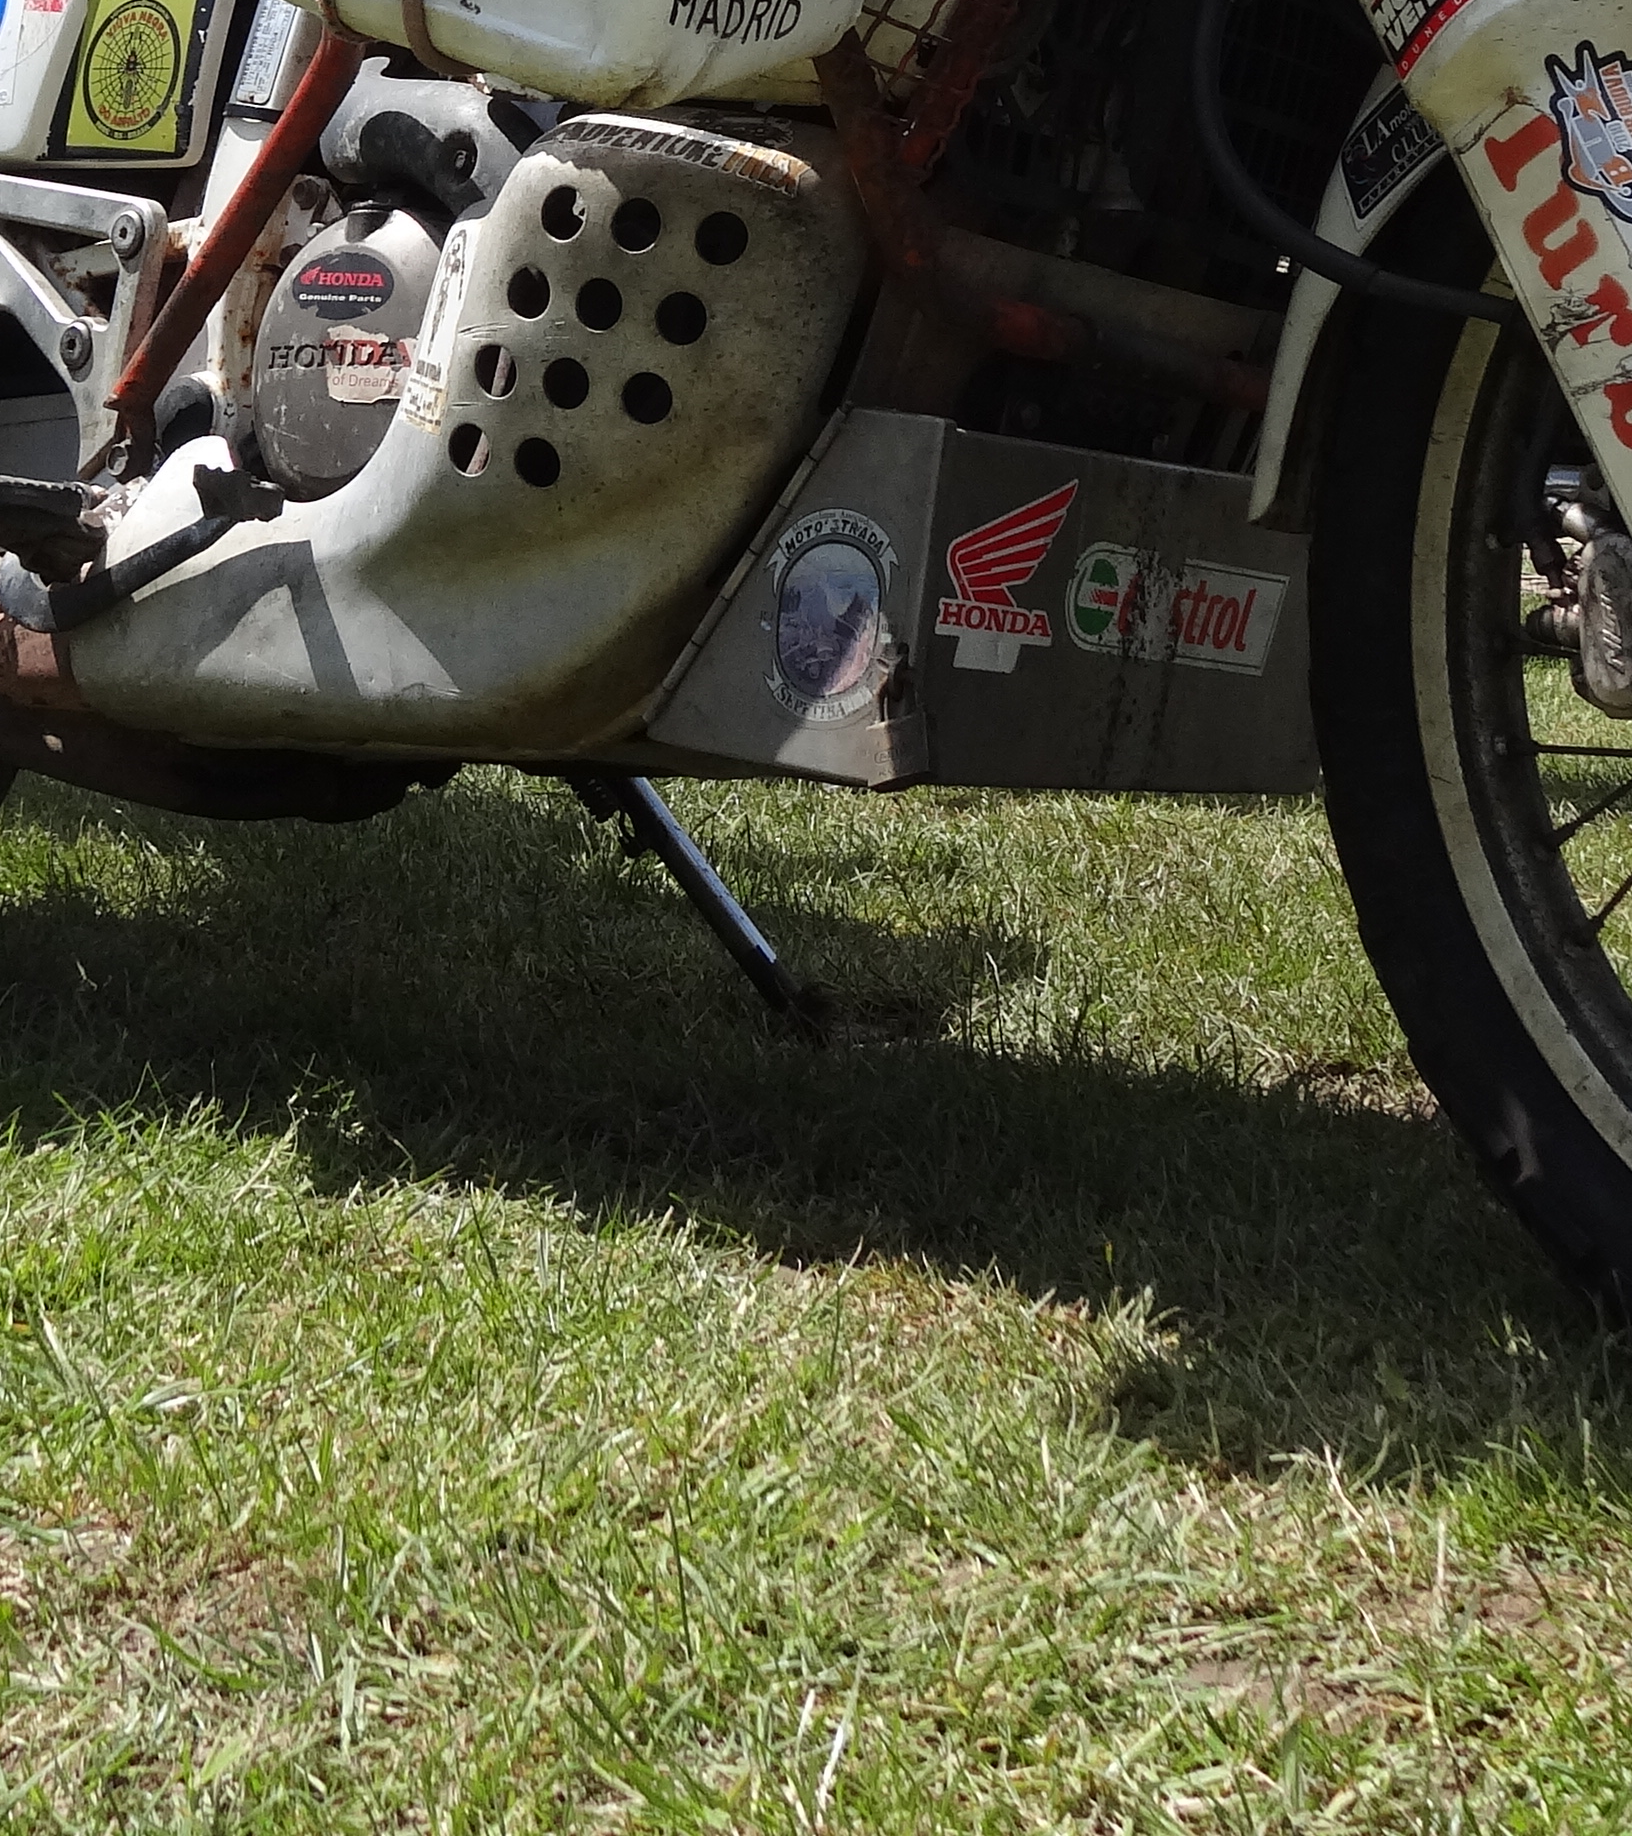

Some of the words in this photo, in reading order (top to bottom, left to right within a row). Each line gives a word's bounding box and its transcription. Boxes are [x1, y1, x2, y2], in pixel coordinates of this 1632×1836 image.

[318, 270, 385, 288] HONDA
[298, 292, 346, 303] Genuine
[349, 294, 383, 305] Parts
[268, 339, 404, 370] HONDA
[331, 373, 347, 387] of
[348, 373, 400, 389] Dreams
[939, 600, 1052, 639] HONDA
